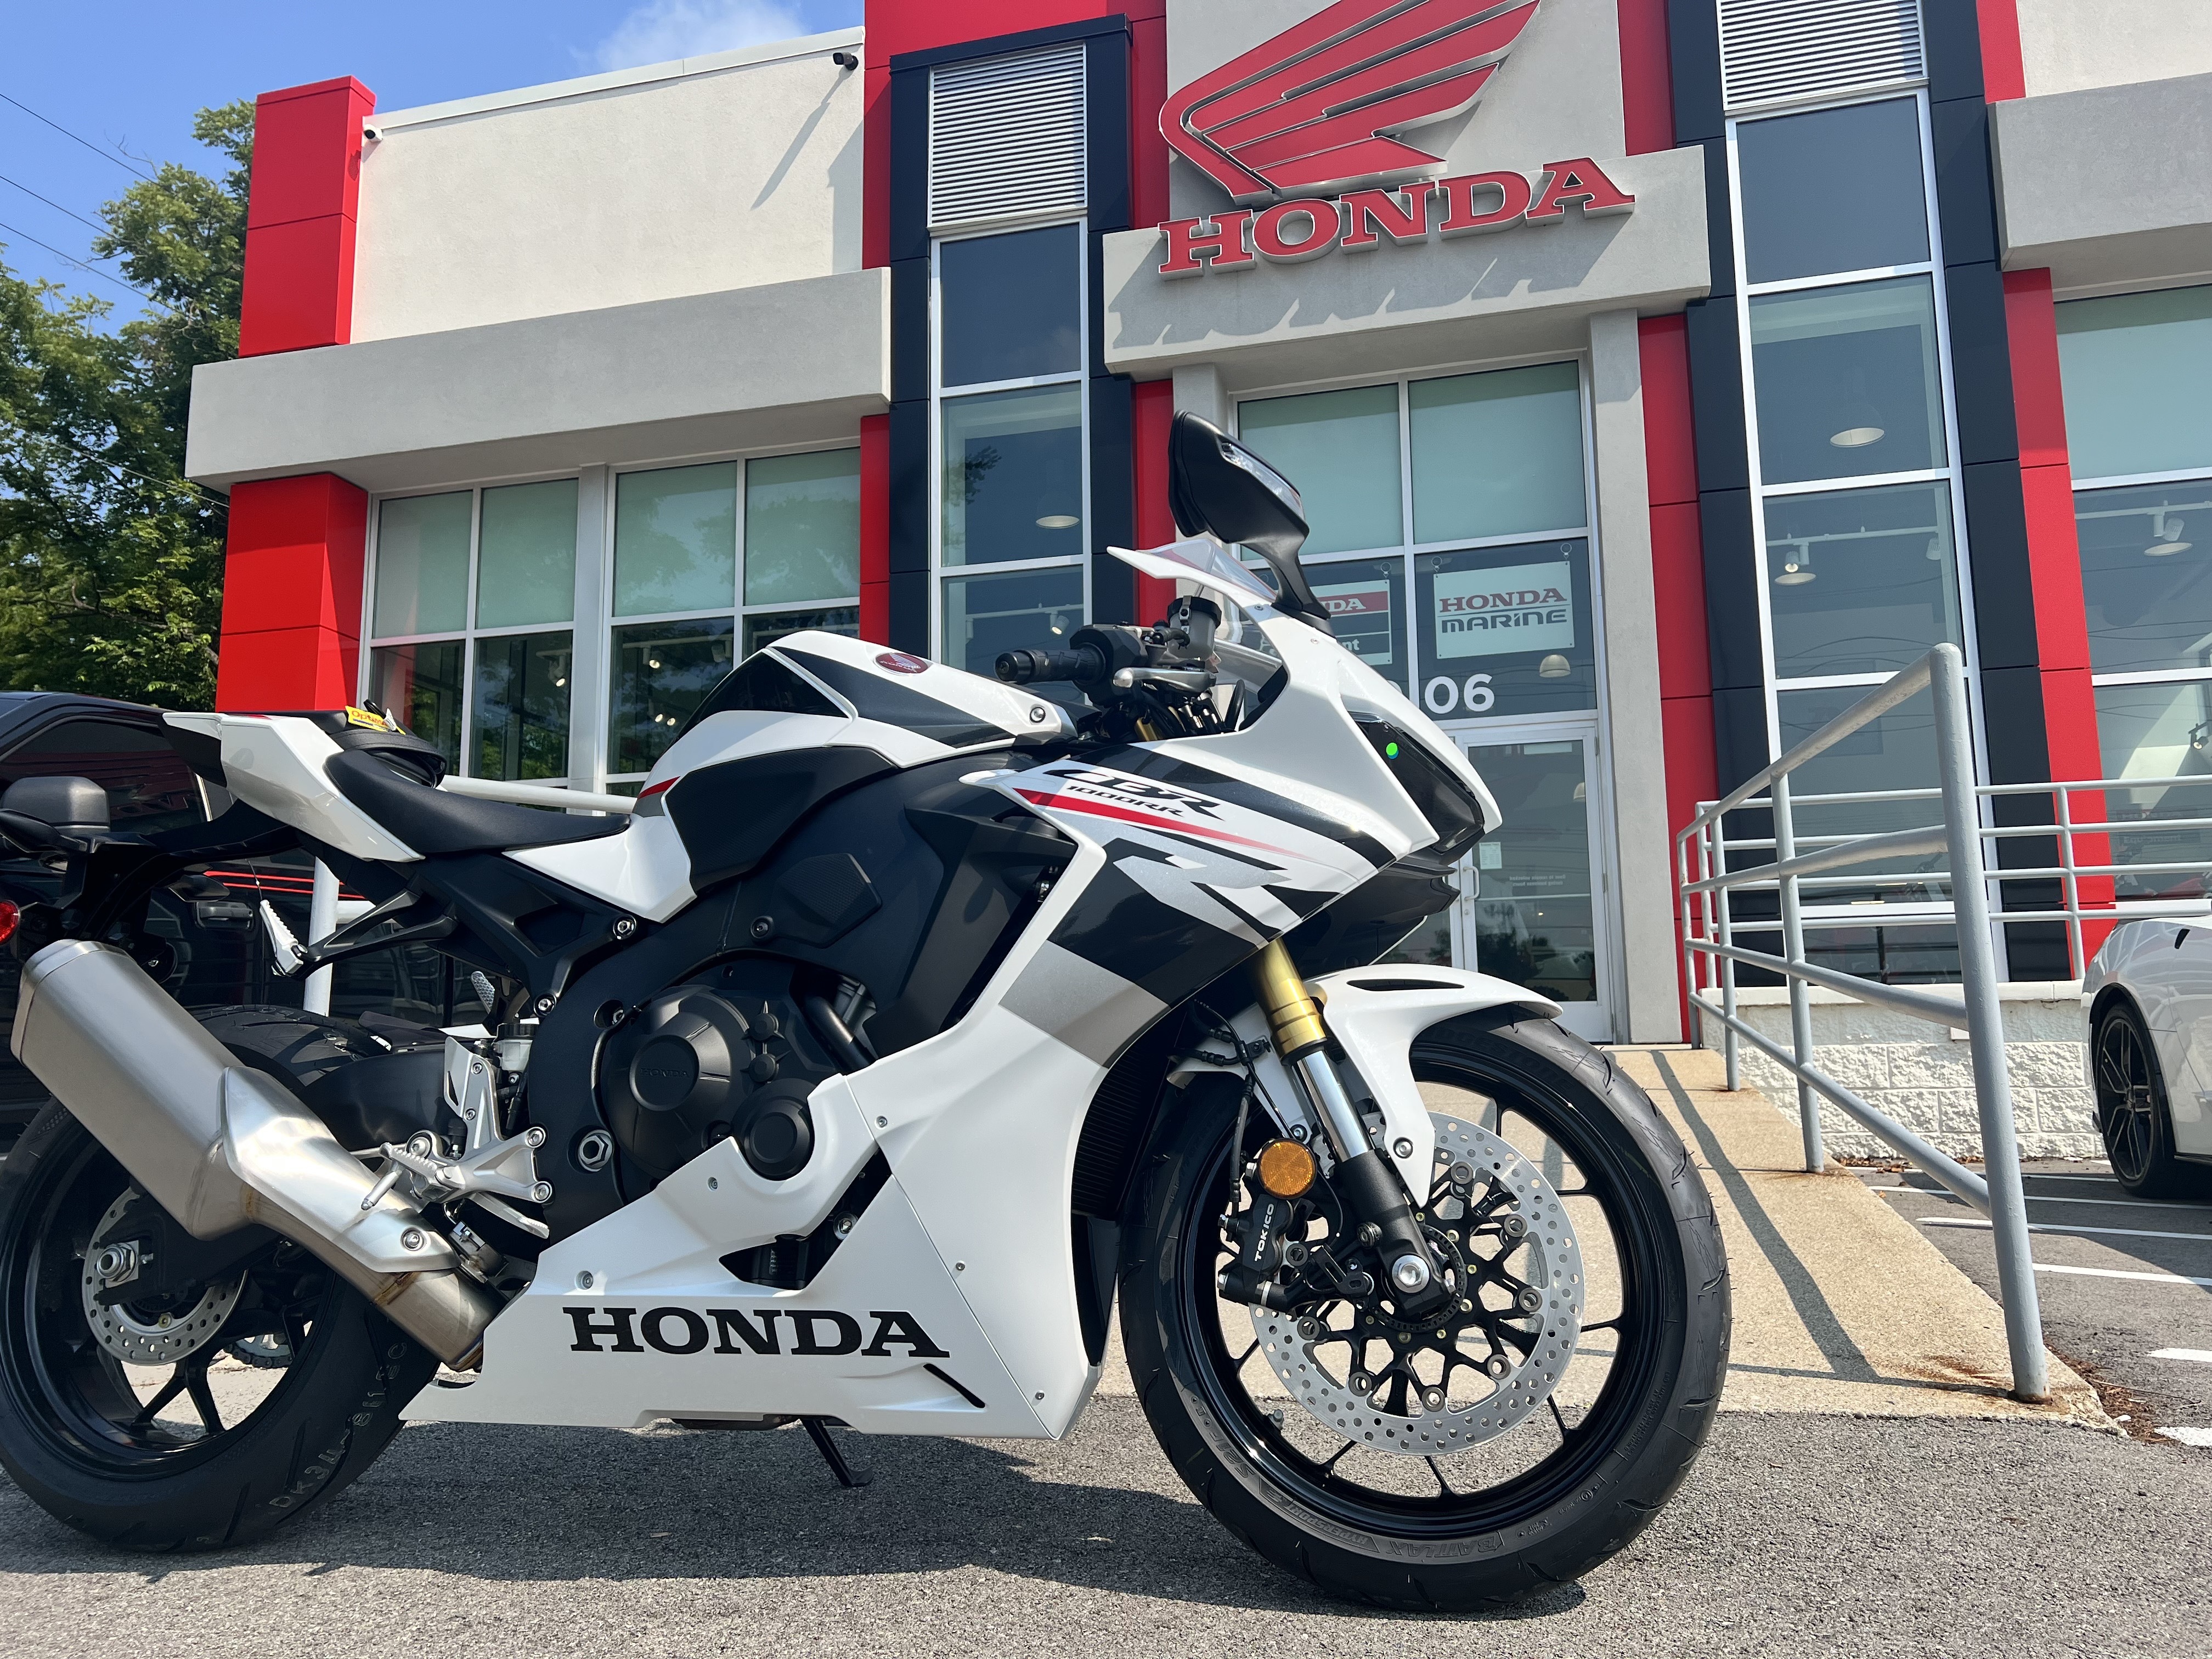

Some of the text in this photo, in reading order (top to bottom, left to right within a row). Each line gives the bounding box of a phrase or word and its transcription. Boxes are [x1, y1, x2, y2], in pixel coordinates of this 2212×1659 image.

[1158, 157, 1635, 279] HONDA
[1440, 588, 1567, 612] HONDA
[1042, 769, 1226, 821] CBR
[1066, 786, 1185, 817] 1000RR
[639, 1066, 690, 1079] HONDA
[1254, 1203, 1274, 1262] TOKICO
[562, 1306, 950, 1358] HONDA
[1282, 1502, 1368, 1545] HYPERSPORT
